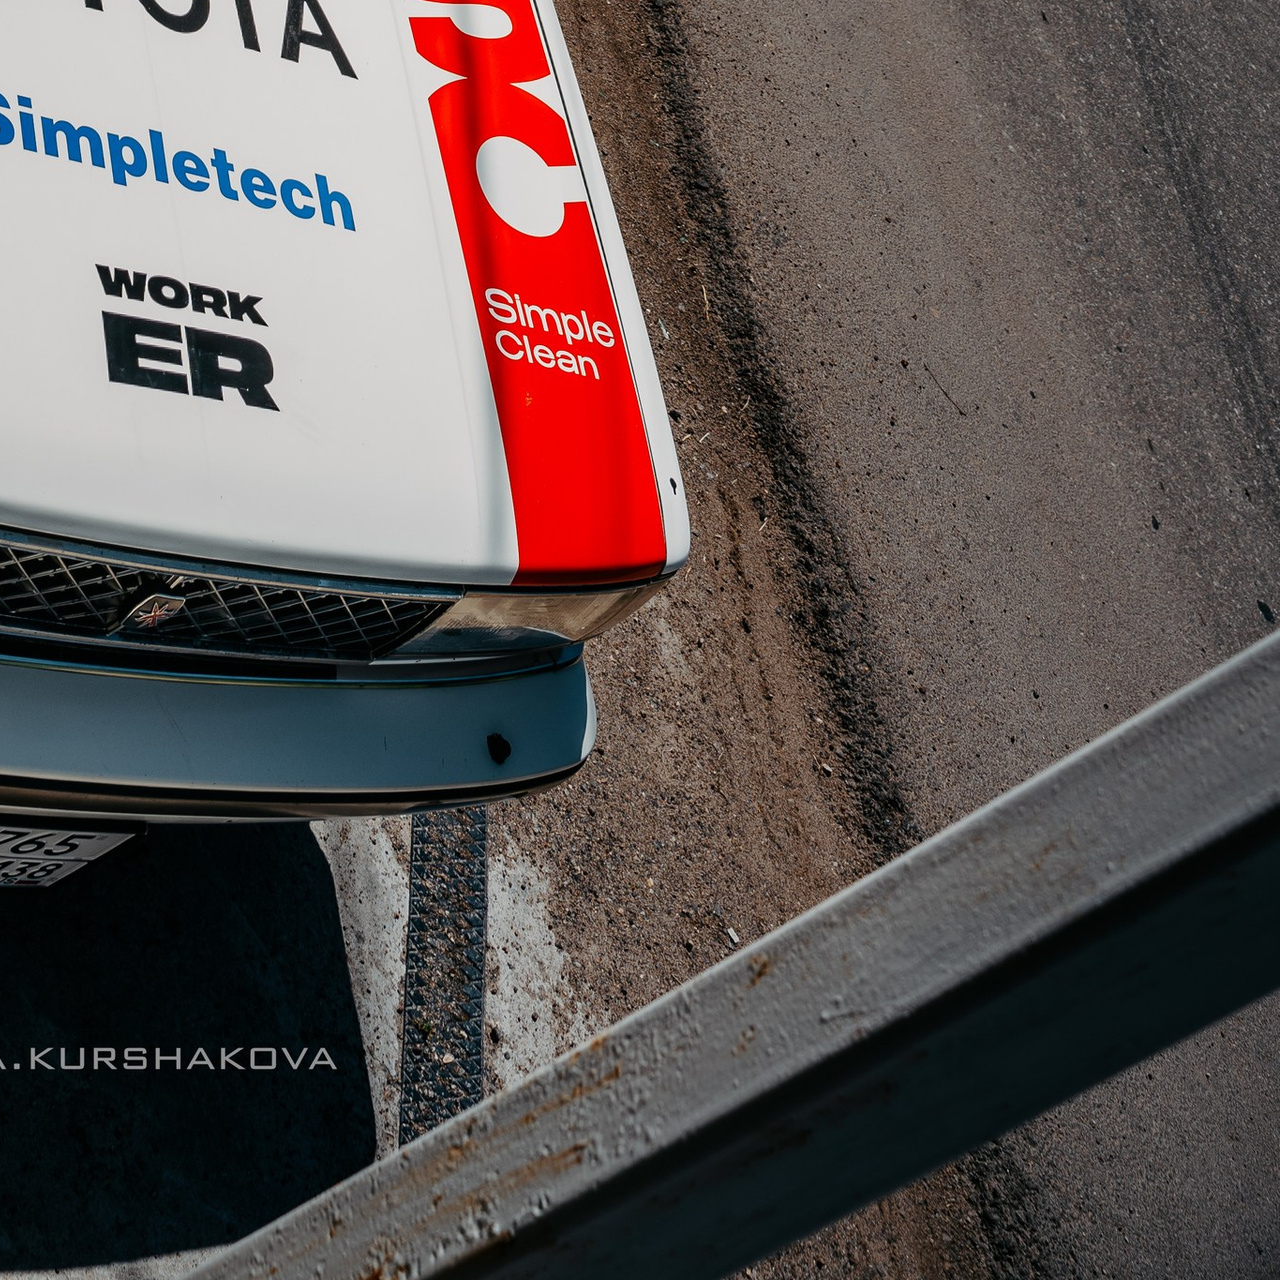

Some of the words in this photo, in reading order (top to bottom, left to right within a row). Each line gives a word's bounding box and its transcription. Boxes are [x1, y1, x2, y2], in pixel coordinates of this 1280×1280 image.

[95, 263, 269, 327] WORK
[484, 286, 616, 348] Simple
[101, 310, 281, 412] ER
[494, 329, 600, 381] Clean
